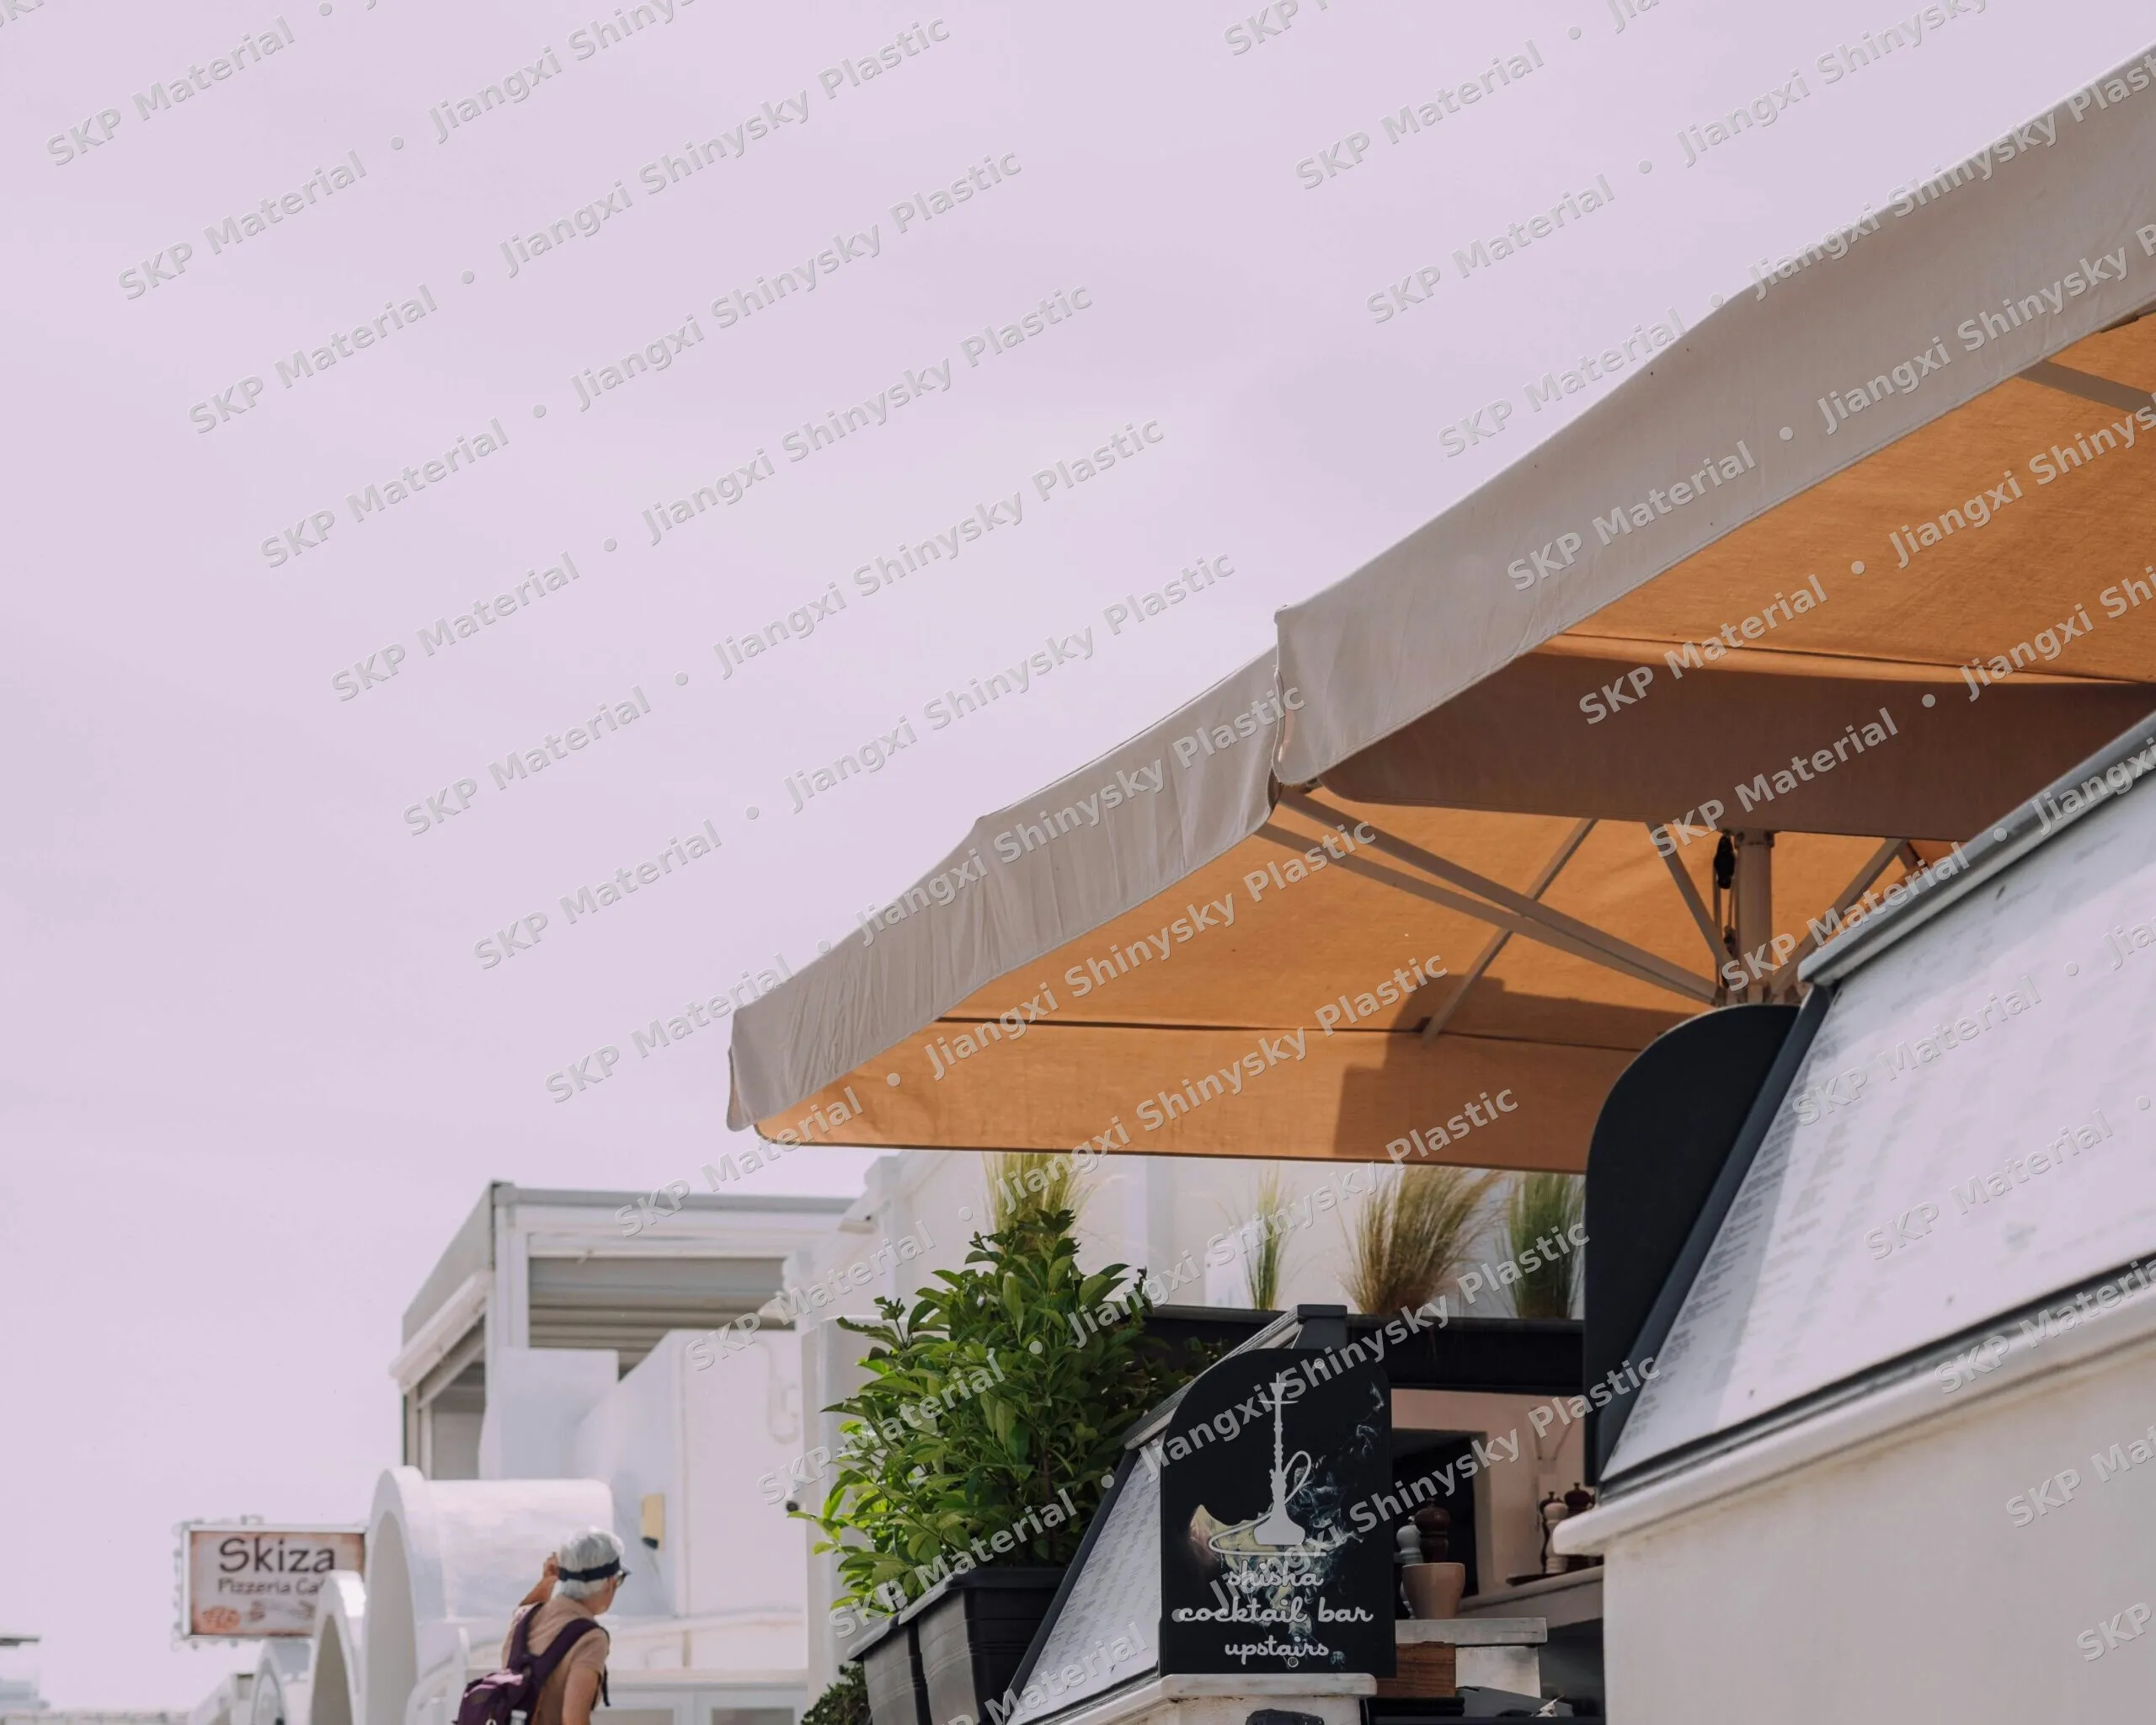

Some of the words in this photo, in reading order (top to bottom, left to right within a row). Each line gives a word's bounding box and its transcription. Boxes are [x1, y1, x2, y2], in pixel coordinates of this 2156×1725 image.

[219, 1537, 335, 1573] Skiza
[218, 1577, 291, 1594] Pizzeria
[1227, 1559, 1324, 1587] shisha
[1178, 1596, 1308, 1623] cocktail
[1317, 1596, 1374, 1623] bar
[1224, 1635, 1329, 1665] upstairs
